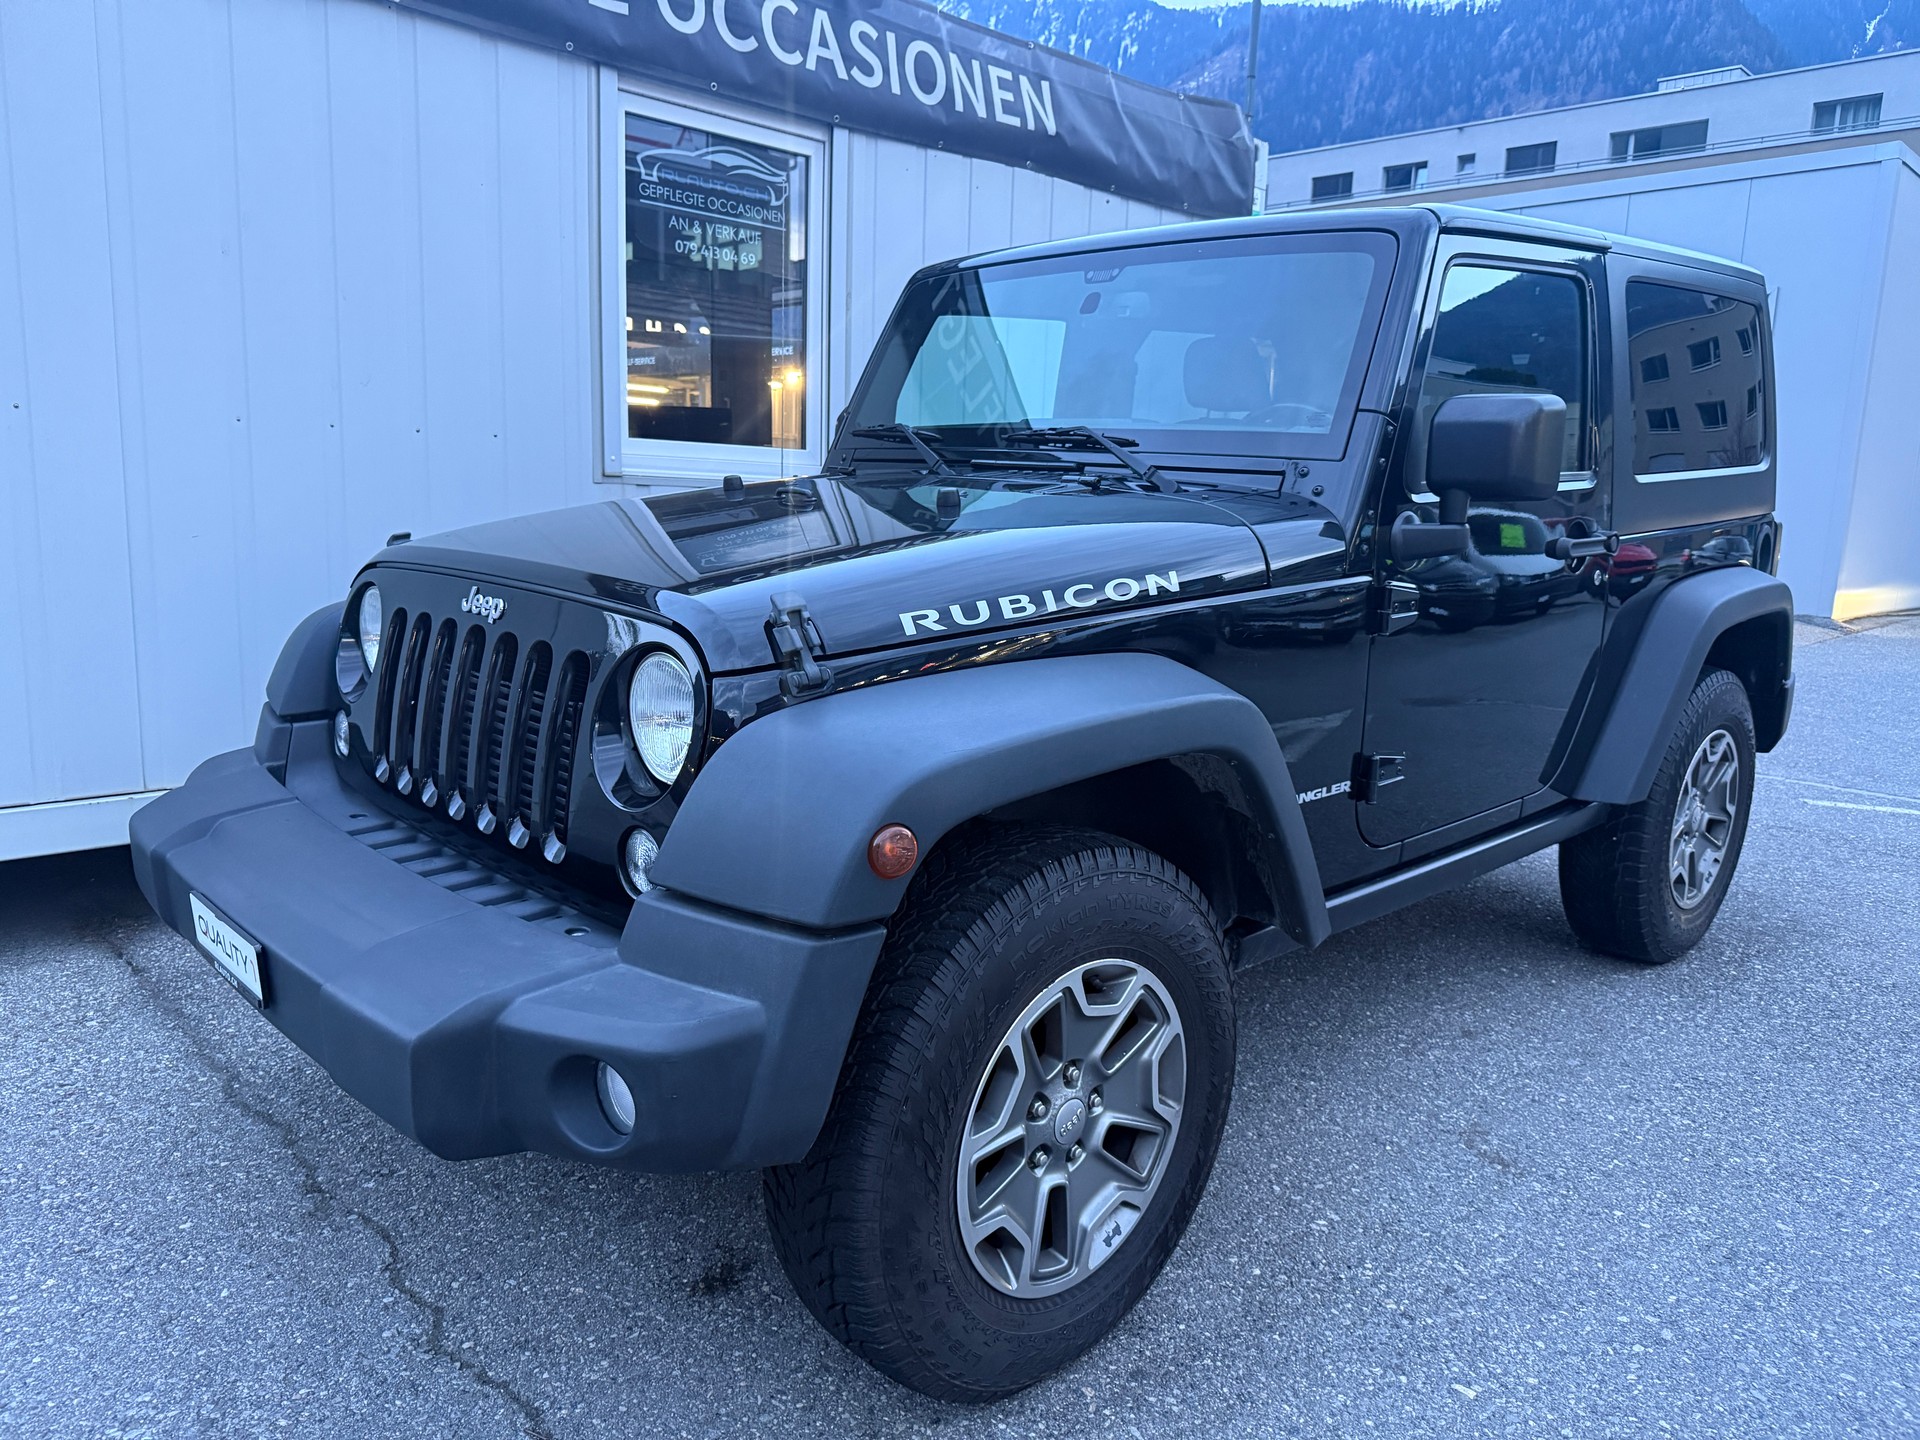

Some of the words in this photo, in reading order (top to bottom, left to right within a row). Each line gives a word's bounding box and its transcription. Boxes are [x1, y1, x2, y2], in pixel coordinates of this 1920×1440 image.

[638, 182, 705, 208] GEPFLEGTE
[707, 196, 785, 224] OCCASIONEN
[668, 215, 689, 232] AN
[692, 220, 702, 235] &
[706, 222, 762, 245] VERKAUF
[675, 239, 698, 255] 079
[701, 244, 720, 260] 413
[722, 245, 738, 263] 04
[740, 250, 756, 266] 69
[461, 585, 505, 624] Jeep
[899, 570, 1181, 636] RUBICON
[1295, 780, 1353, 804] NGLER
[1105, 893, 1175, 918] TYRES
[198, 914, 249, 974] QUALITY
